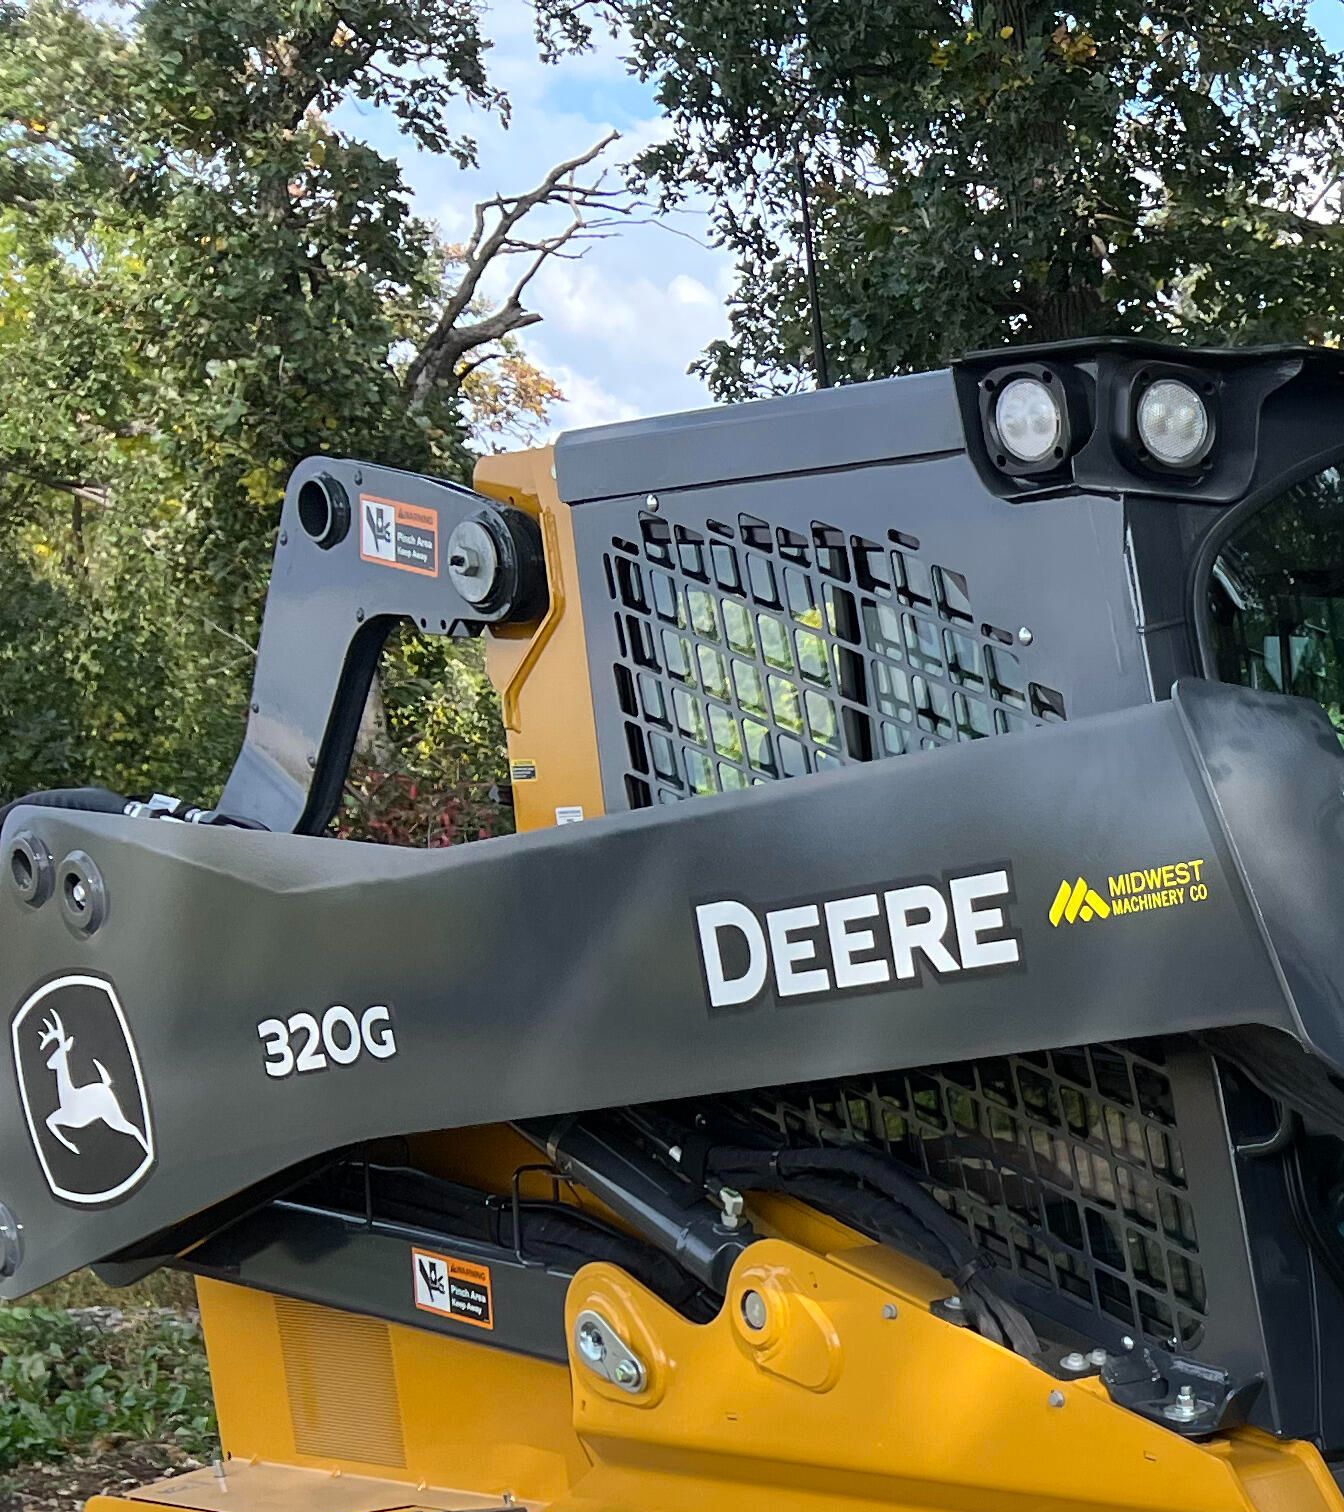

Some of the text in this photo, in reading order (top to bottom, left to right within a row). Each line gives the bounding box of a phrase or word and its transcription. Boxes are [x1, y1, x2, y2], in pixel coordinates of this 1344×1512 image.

[416, 536, 433, 549] Area
[1107, 859, 1204, 898] MIDWEST
[1111, 883, 1208, 916] MACHINERY CO
[695, 870, 1020, 1008] DEERE
[257, 1005, 397, 1077] 320G
[450, 1284, 487, 1303] Pinch Area
[451, 1298, 483, 1316] Keep Away
